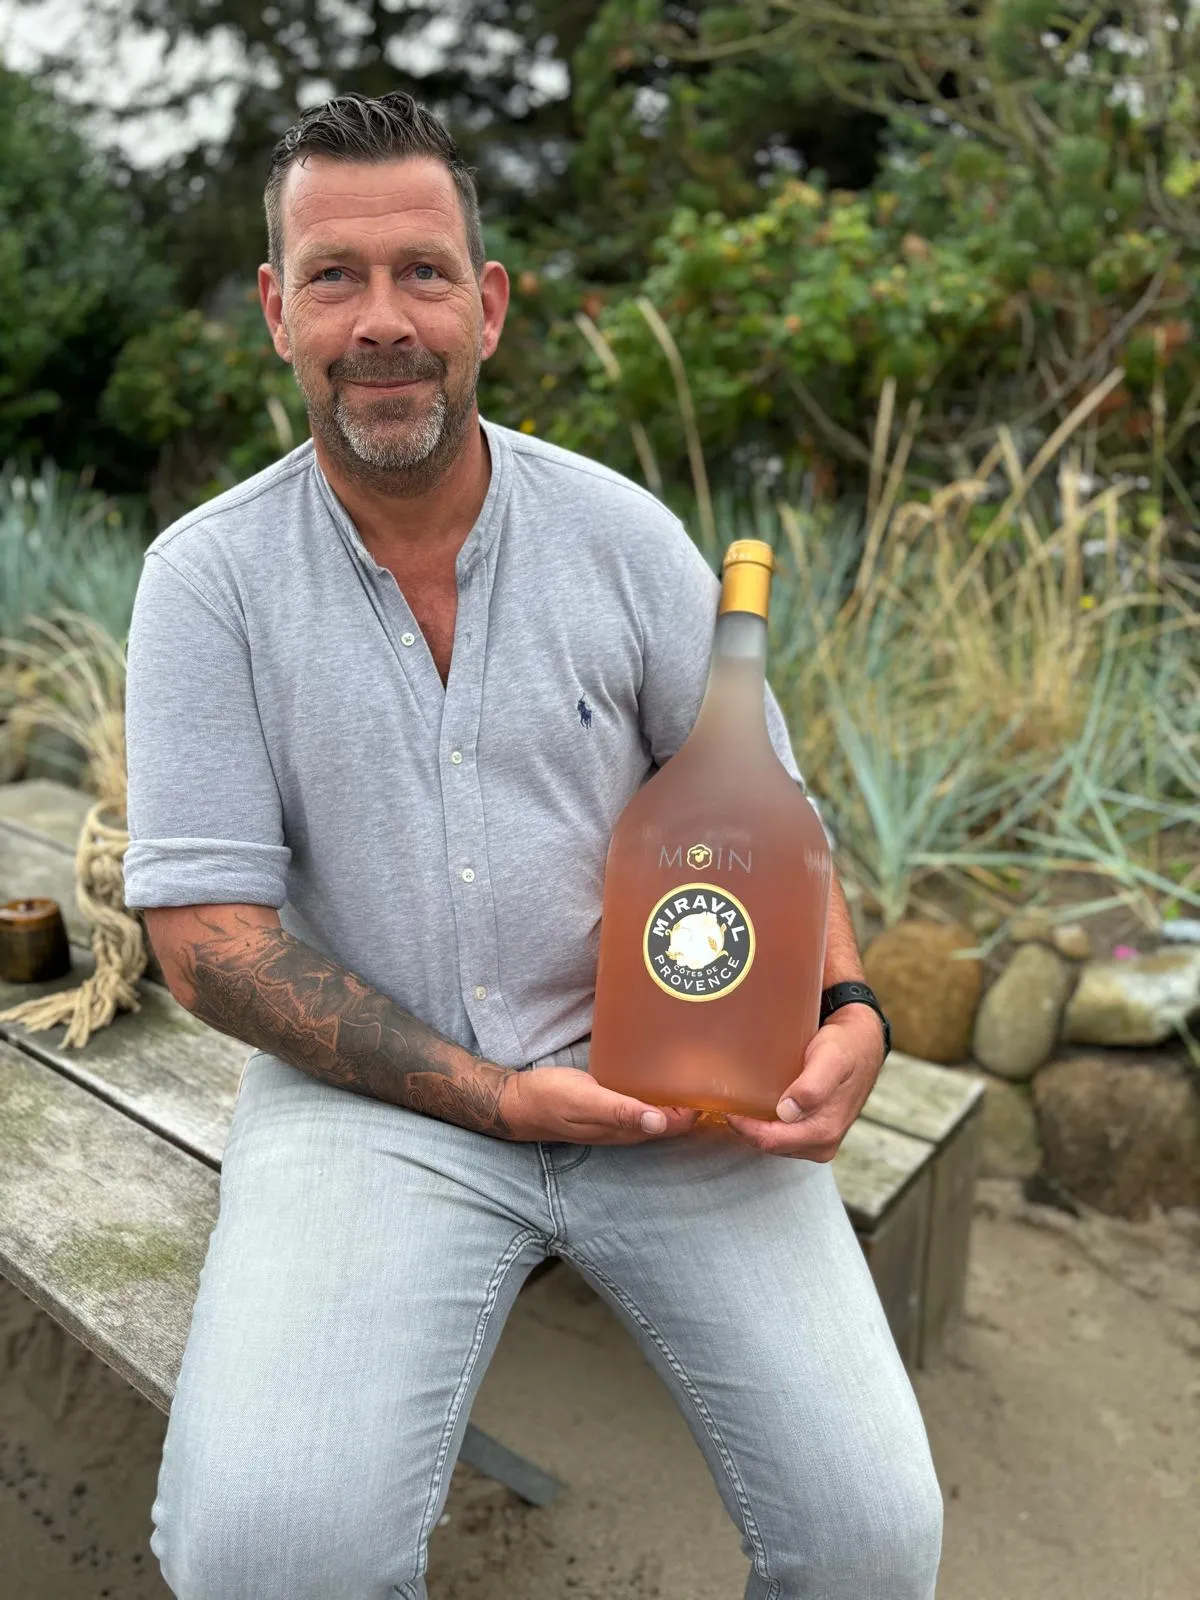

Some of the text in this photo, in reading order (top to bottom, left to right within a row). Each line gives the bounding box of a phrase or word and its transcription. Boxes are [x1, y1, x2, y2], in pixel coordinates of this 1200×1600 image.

[652, 895, 745, 942] MIRAVAL
[654, 954, 740, 992] PROVENCE
[706, 965, 718, 976] DE
